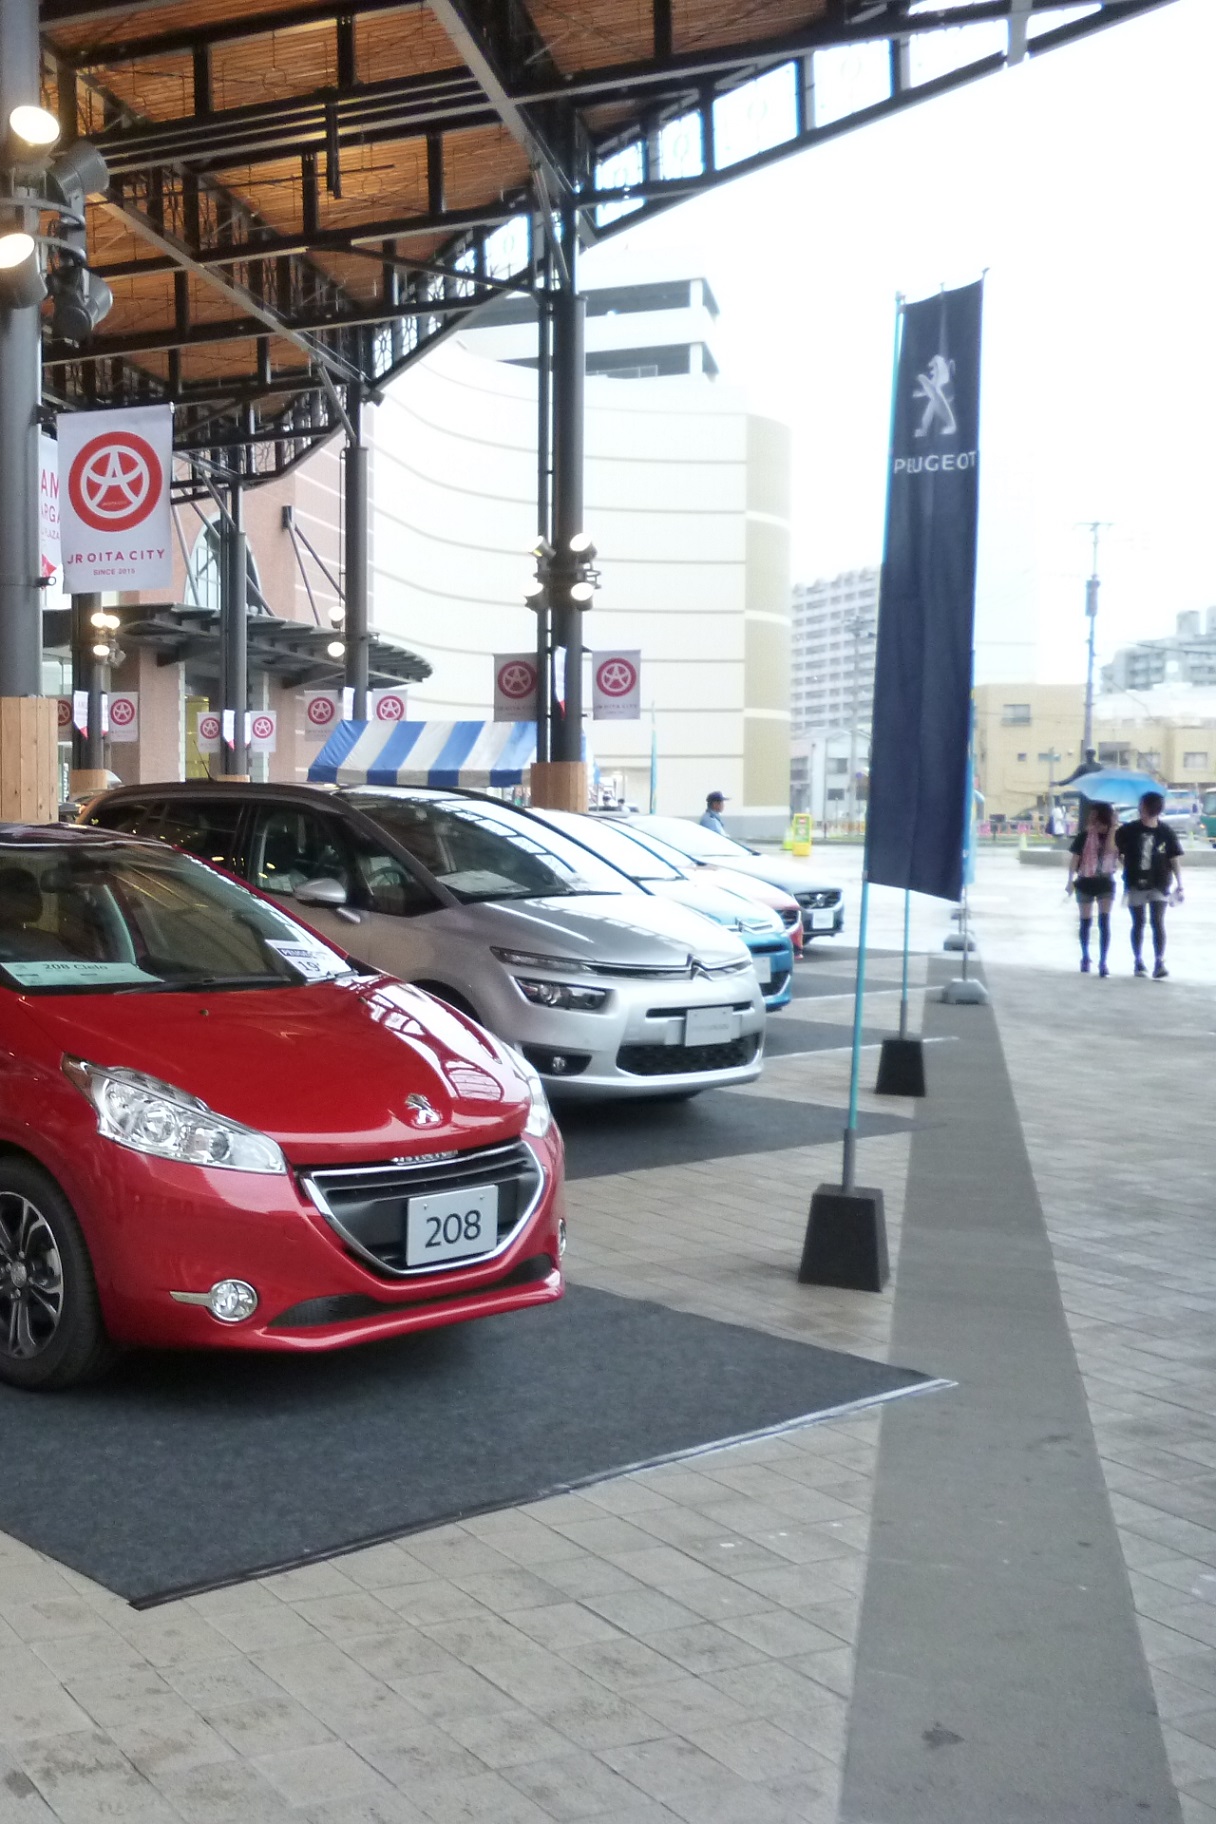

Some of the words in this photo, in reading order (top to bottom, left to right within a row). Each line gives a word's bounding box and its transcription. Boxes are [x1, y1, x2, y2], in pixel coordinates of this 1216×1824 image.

[67, 553, 84, 565] JR
[86, 551, 125, 564] OITA
[128, 548, 166, 561] CITY
[92, 568, 117, 577] SINCE
[424, 1209, 482, 1249] 208
